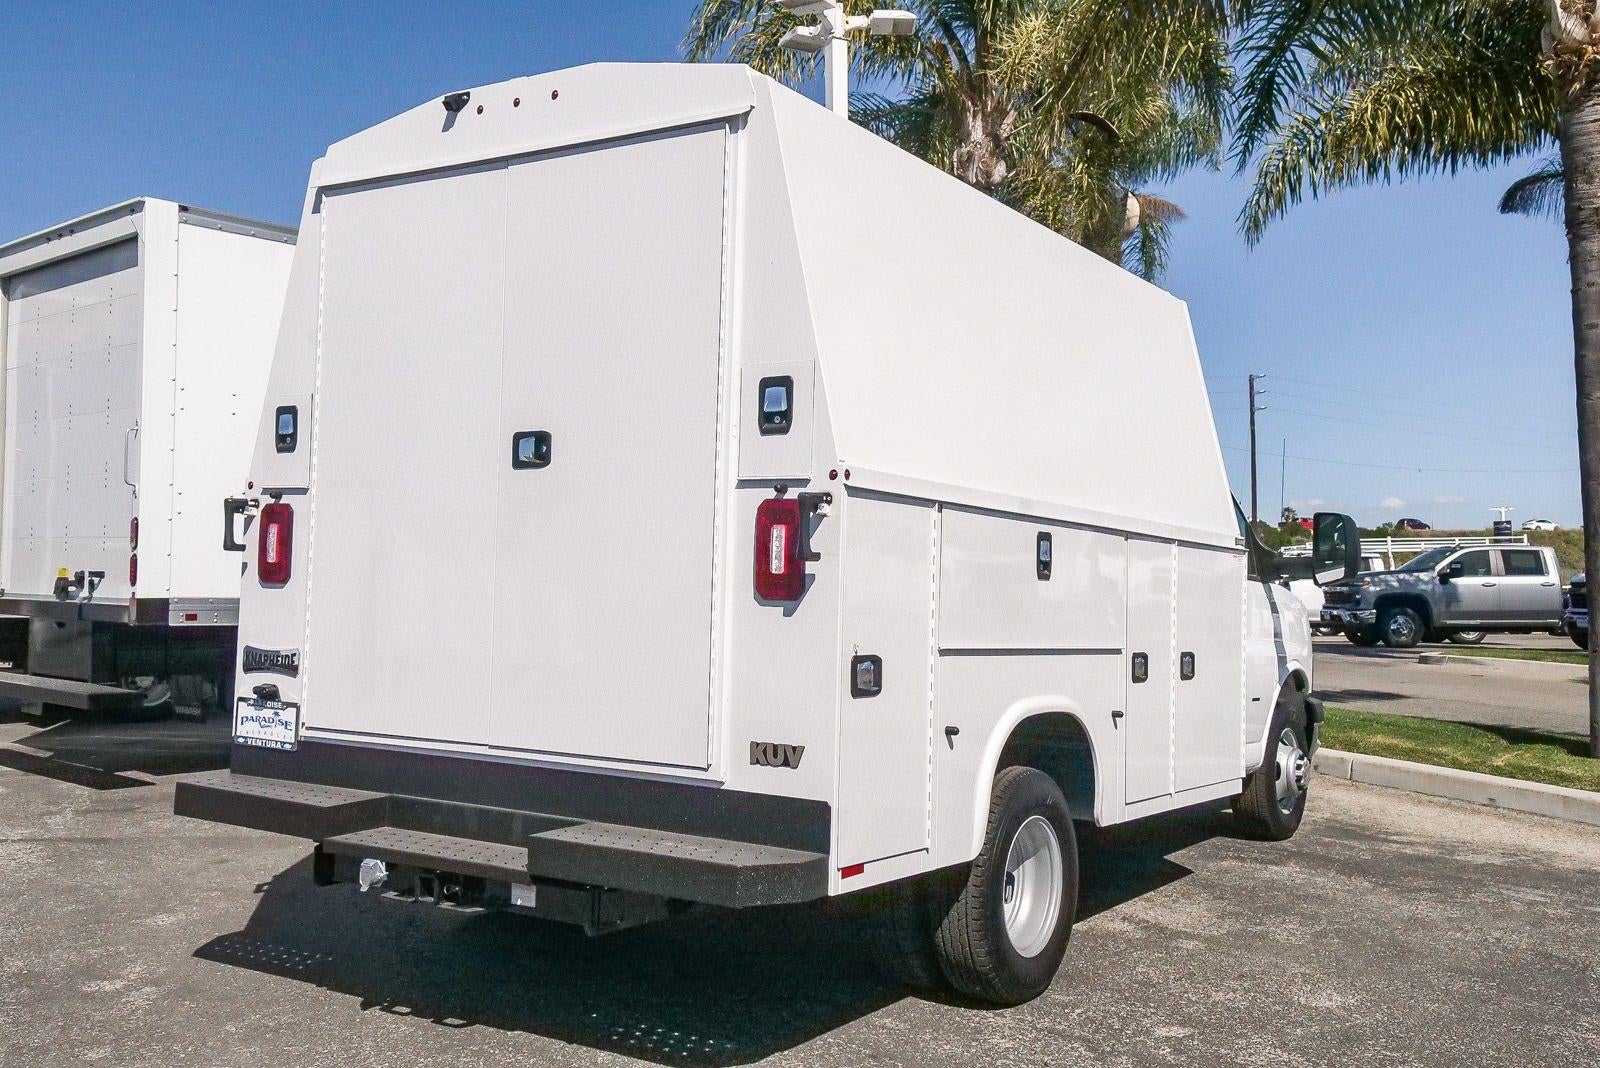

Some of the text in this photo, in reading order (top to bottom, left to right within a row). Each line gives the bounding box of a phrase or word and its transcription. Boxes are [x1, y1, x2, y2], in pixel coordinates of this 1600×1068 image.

[240, 715, 293, 731] PARADISE
[247, 738, 282, 749] VENTURA
[750, 741, 805, 769] KUV
